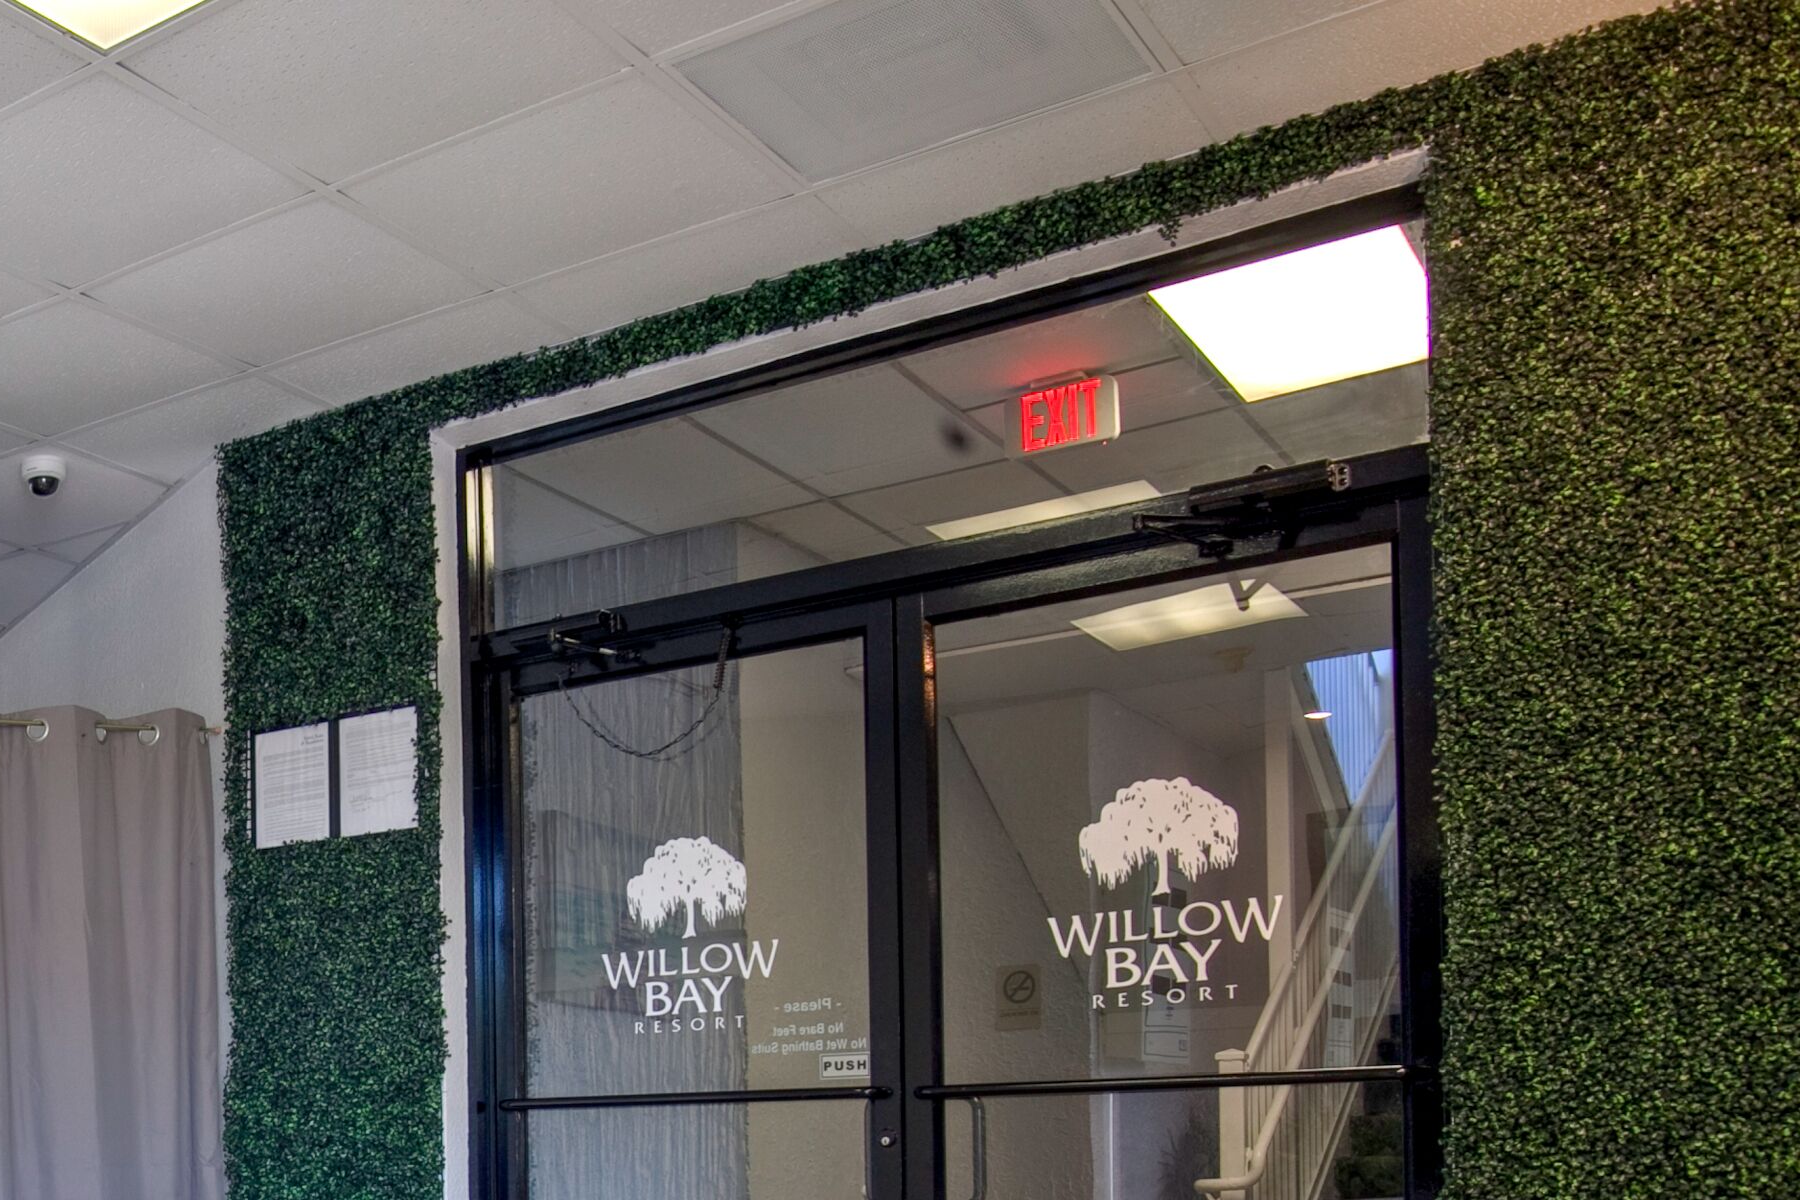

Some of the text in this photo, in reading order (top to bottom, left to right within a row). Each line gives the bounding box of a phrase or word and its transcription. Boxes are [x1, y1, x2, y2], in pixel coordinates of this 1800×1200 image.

[1021, 379, 1101, 452] EXIT
[1046, 894, 1283, 959] WILLOW
[601, 938, 780, 990] WILLOW
[1105, 938, 1223, 989] BAY
[645, 976, 732, 1017] BAY
[1092, 984, 1239, 1009] RESORT
[634, 1014, 745, 1034] RESORT
[823, 1060, 867, 1072] PUSH
